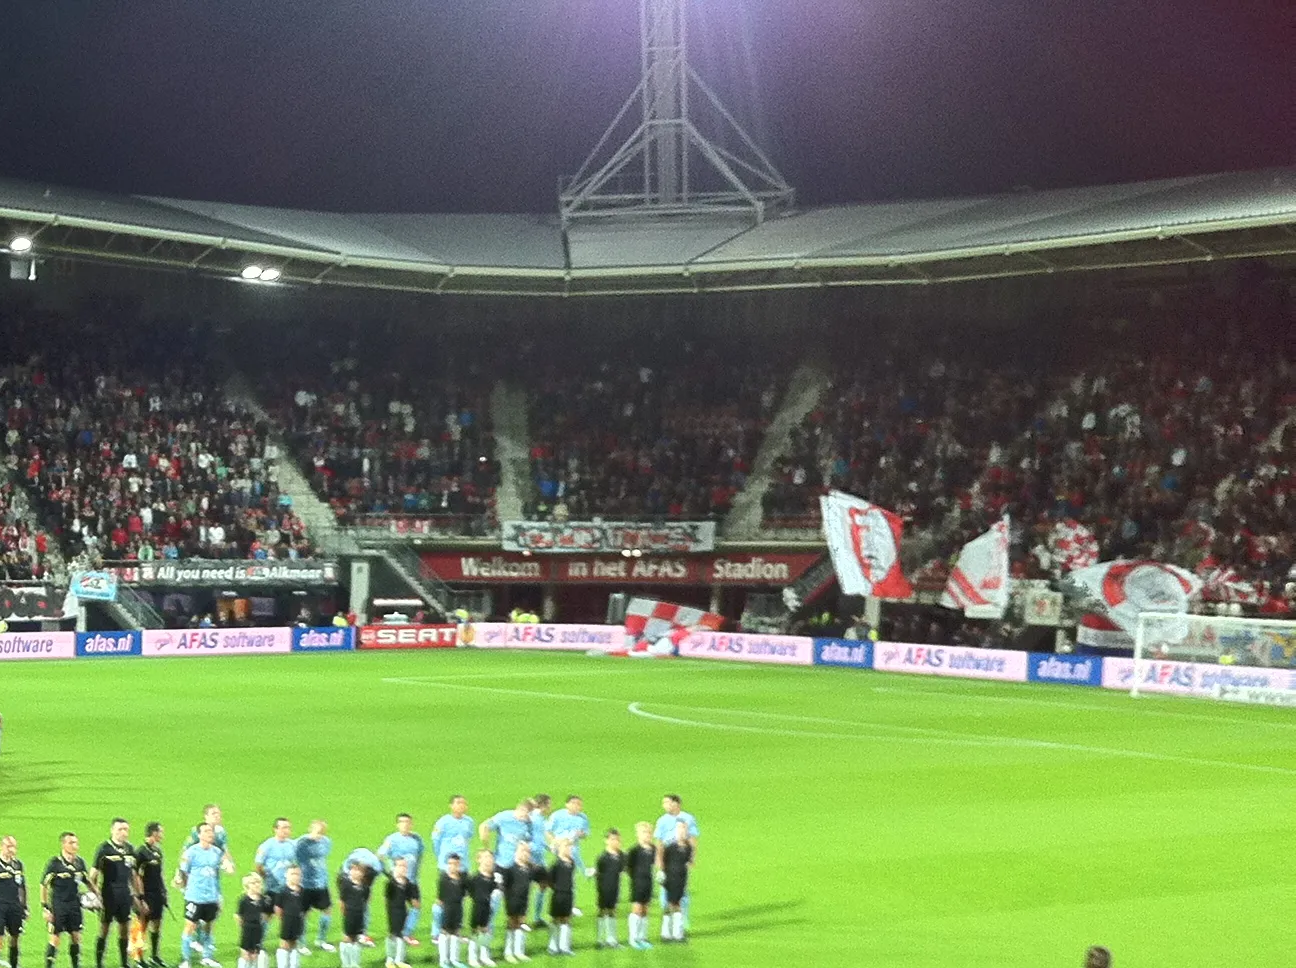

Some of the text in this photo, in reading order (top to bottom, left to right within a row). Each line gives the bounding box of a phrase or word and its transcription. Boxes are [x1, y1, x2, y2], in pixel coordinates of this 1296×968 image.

[157, 567, 323, 582] All you need is Alkmaar
[461, 557, 541, 577] Welkom
[568, 557, 589, 577] in
[593, 557, 627, 577] het
[713, 557, 789, 579] Stadion
[85, 634, 133, 653] afas.nl
[177, 631, 275, 649] AFAS software
[299, 630, 345, 647] afas.nl
[376, 628, 457, 644] SEAT
[507, 626, 614, 644] AFAS software
[904, 647, 945, 667] AFAS
[1144, 664, 1195, 687] AFAS
